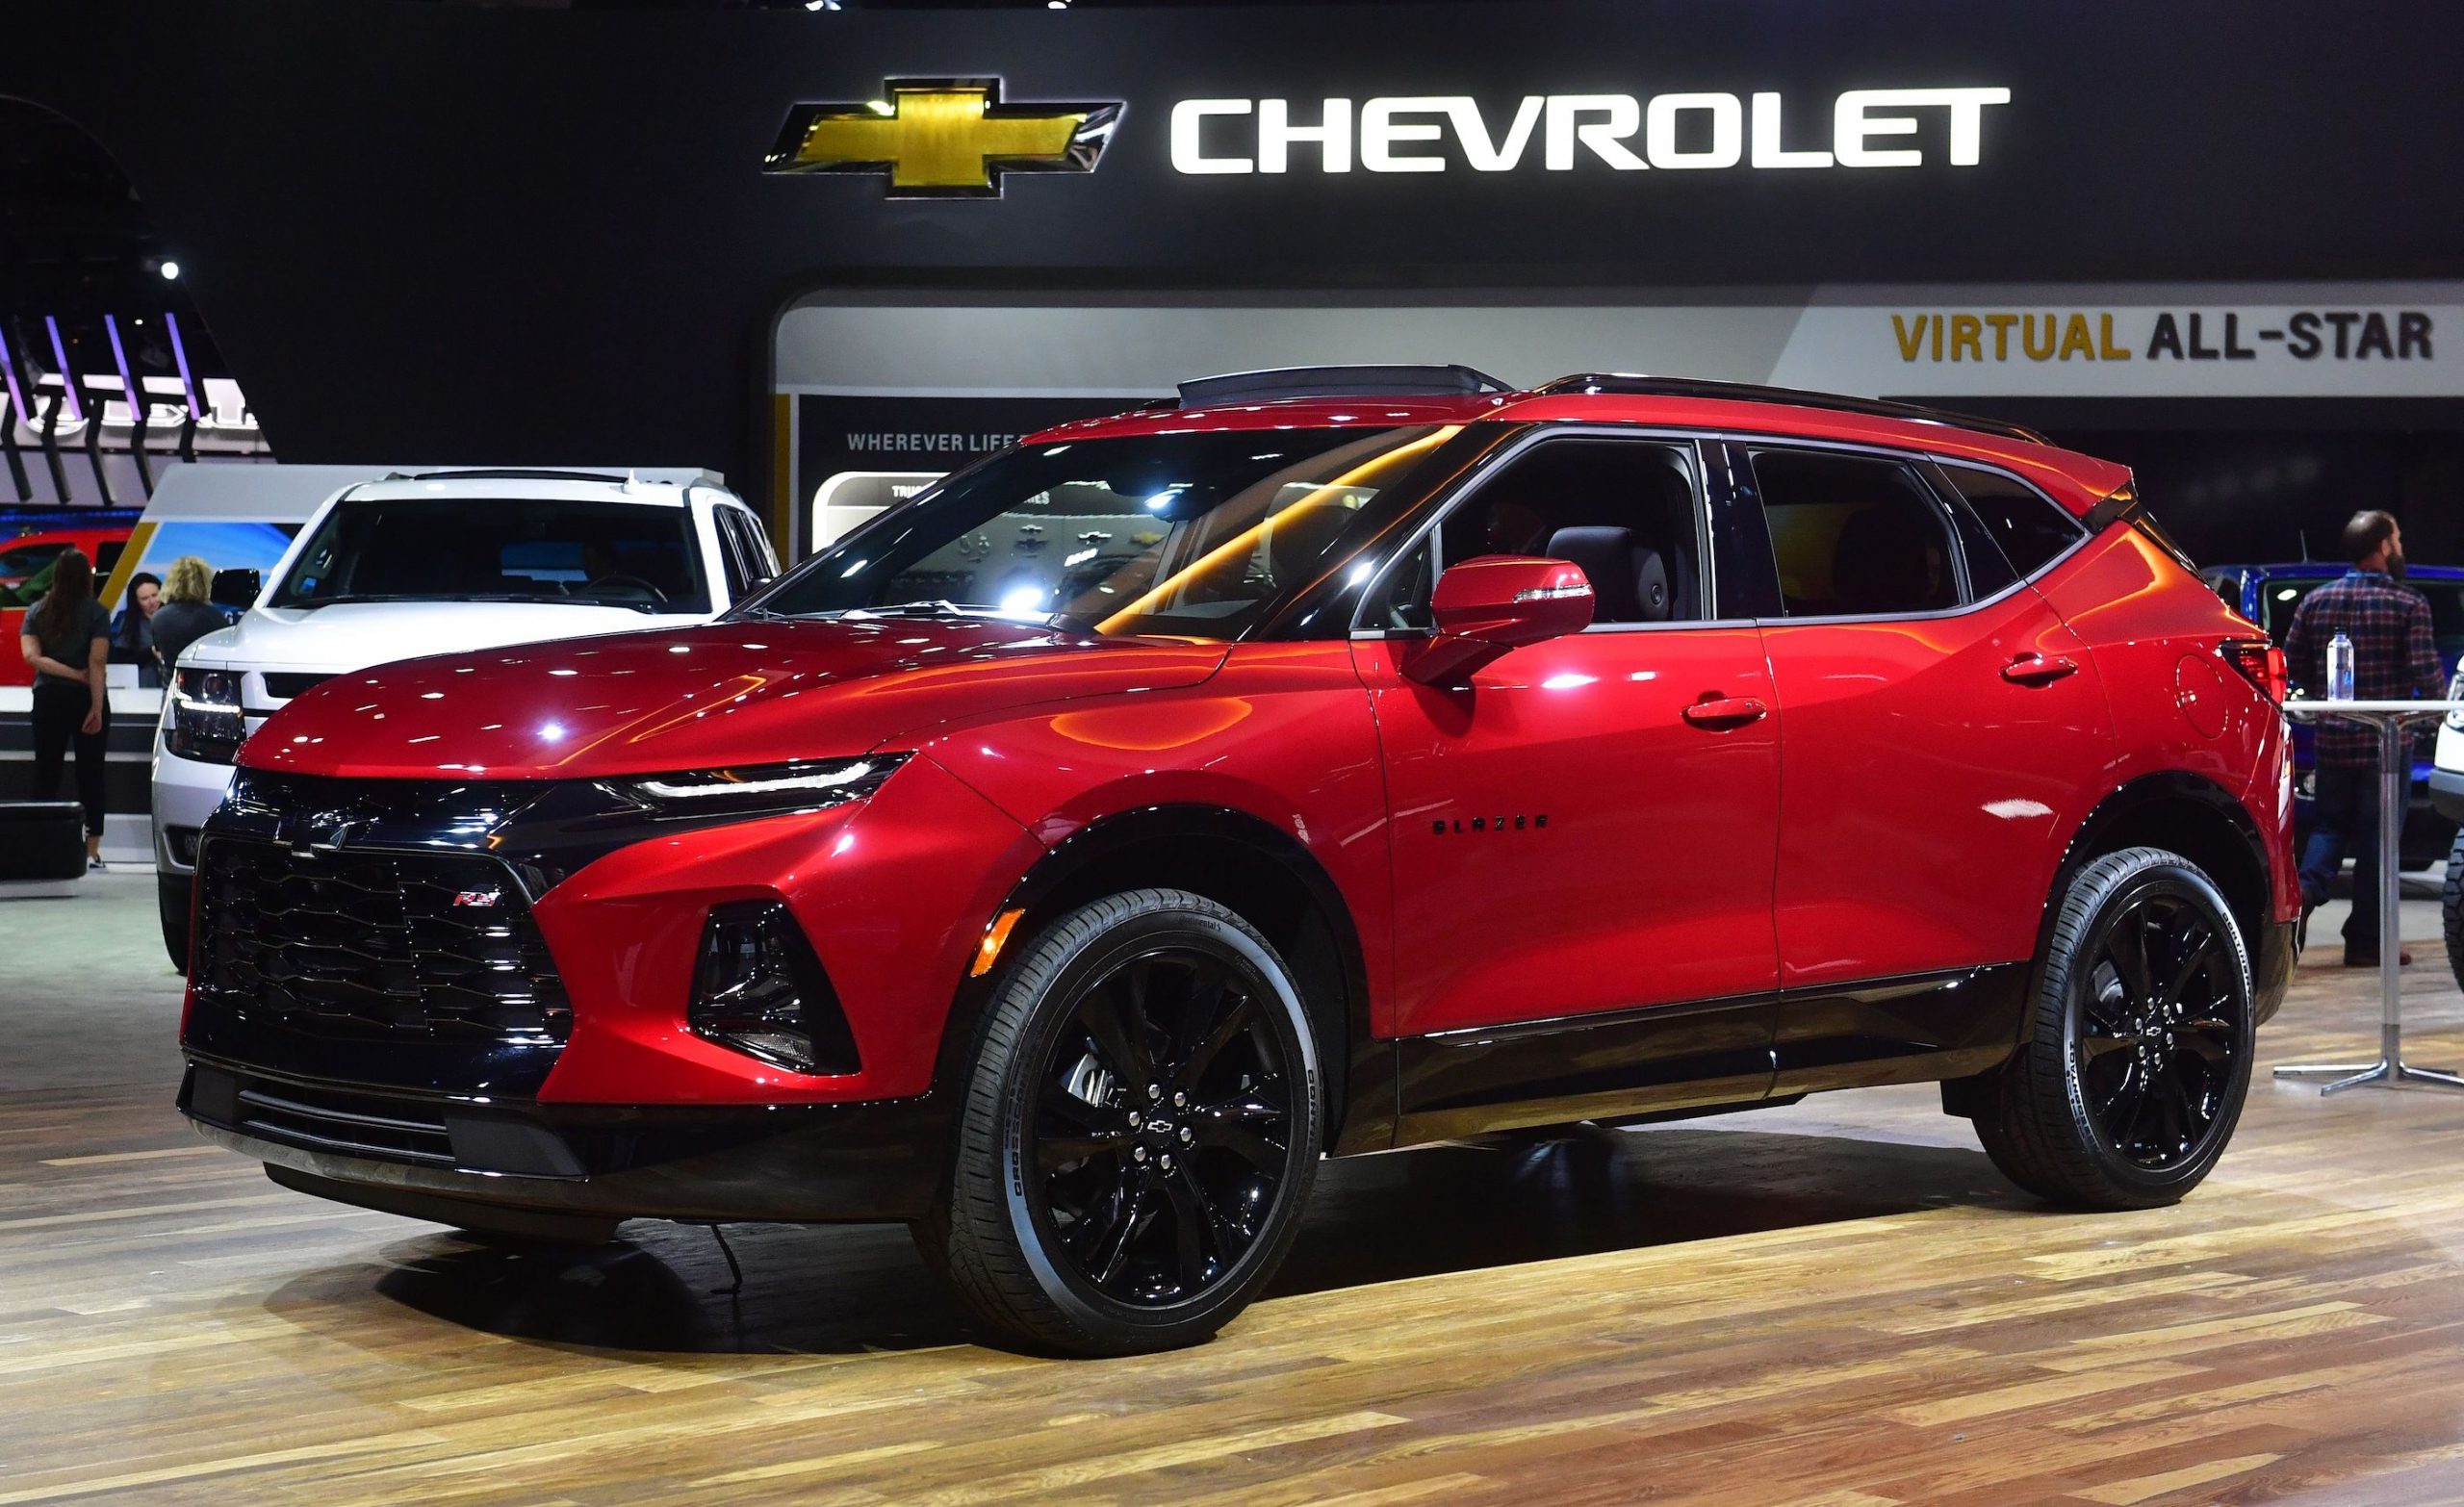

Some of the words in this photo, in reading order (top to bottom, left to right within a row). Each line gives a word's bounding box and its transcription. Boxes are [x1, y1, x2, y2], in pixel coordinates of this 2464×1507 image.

[1169, 87, 2012, 174] CHEVROLET
[1891, 314, 2132, 362] VIRTUAL
[2146, 313, 2434, 361] ALL-STAR
[100, 399, 259, 430] LEXU
[848, 433, 963, 451] WHEREVER
[1432, 815, 1548, 835] BLAZER
[453, 891, 500, 907] RS
